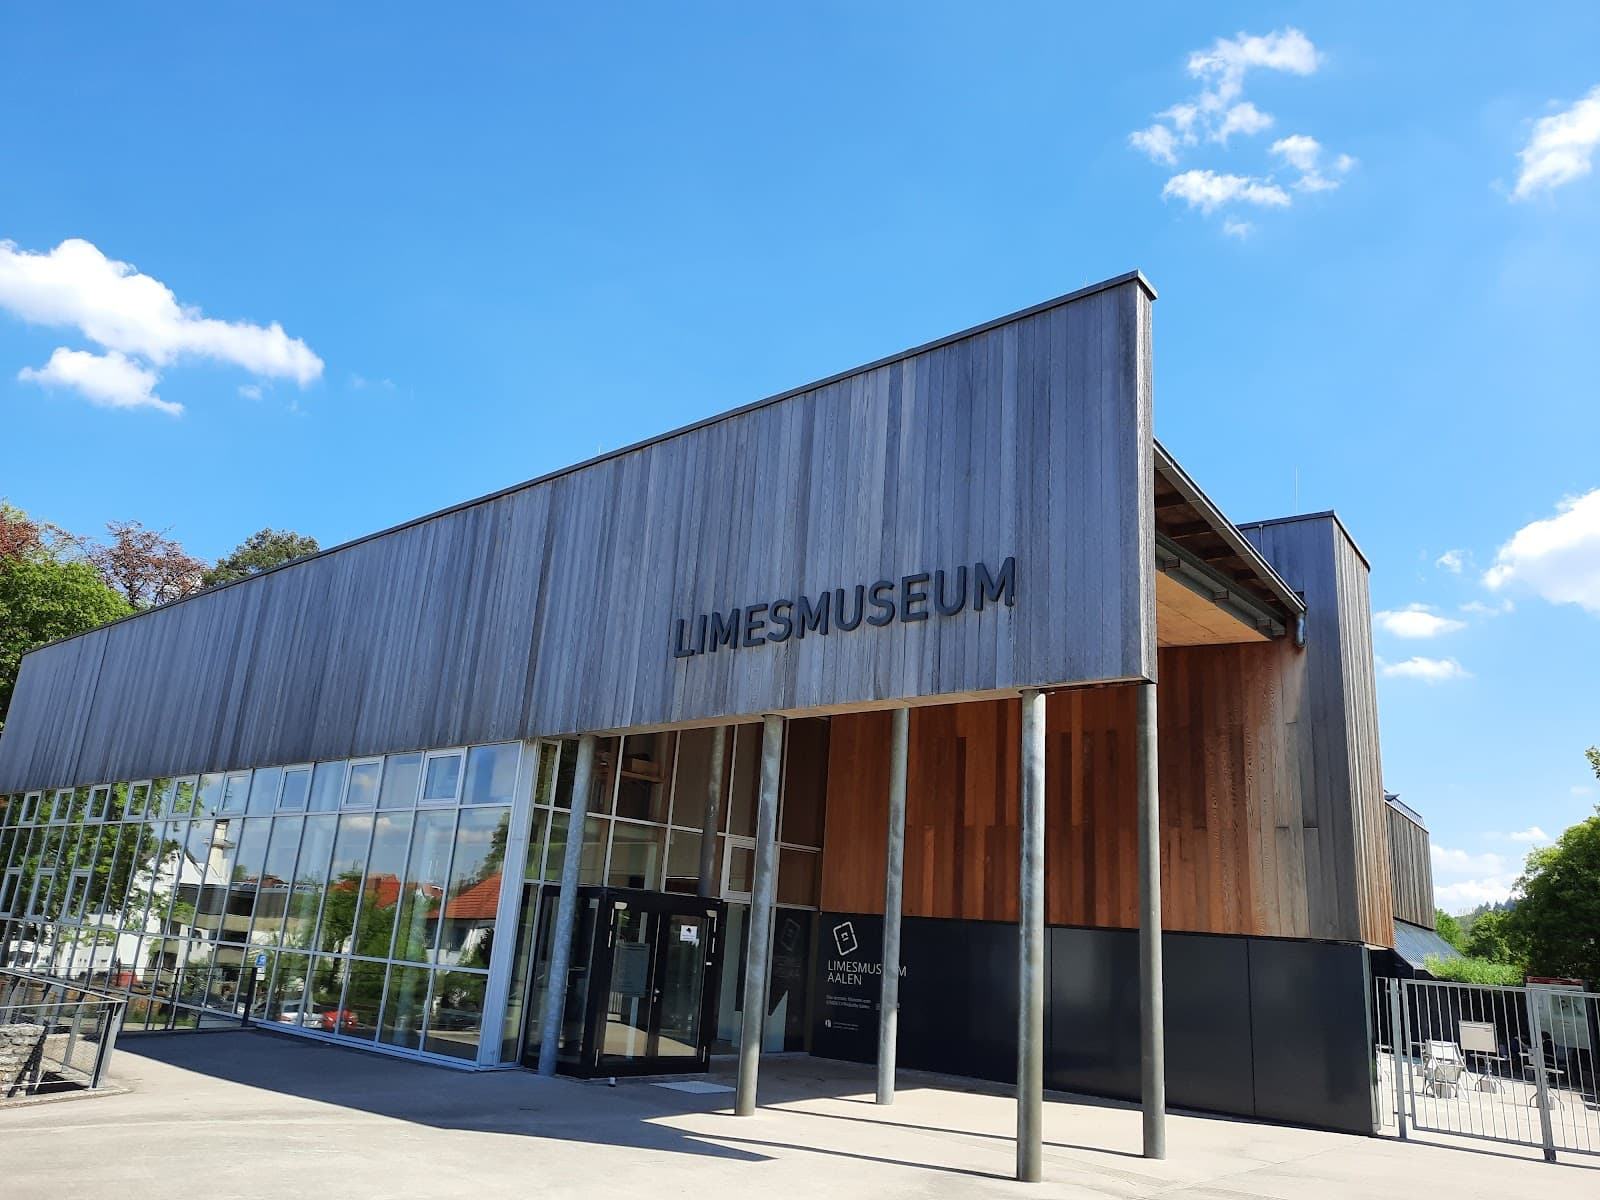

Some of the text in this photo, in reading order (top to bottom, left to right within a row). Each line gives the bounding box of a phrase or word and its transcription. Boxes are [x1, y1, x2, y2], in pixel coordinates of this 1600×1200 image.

[674, 556, 1016, 659] LIMESMUSEUM
[827, 960, 907, 977] LIMESMUSM
[827, 972, 862, 985] AALEN
